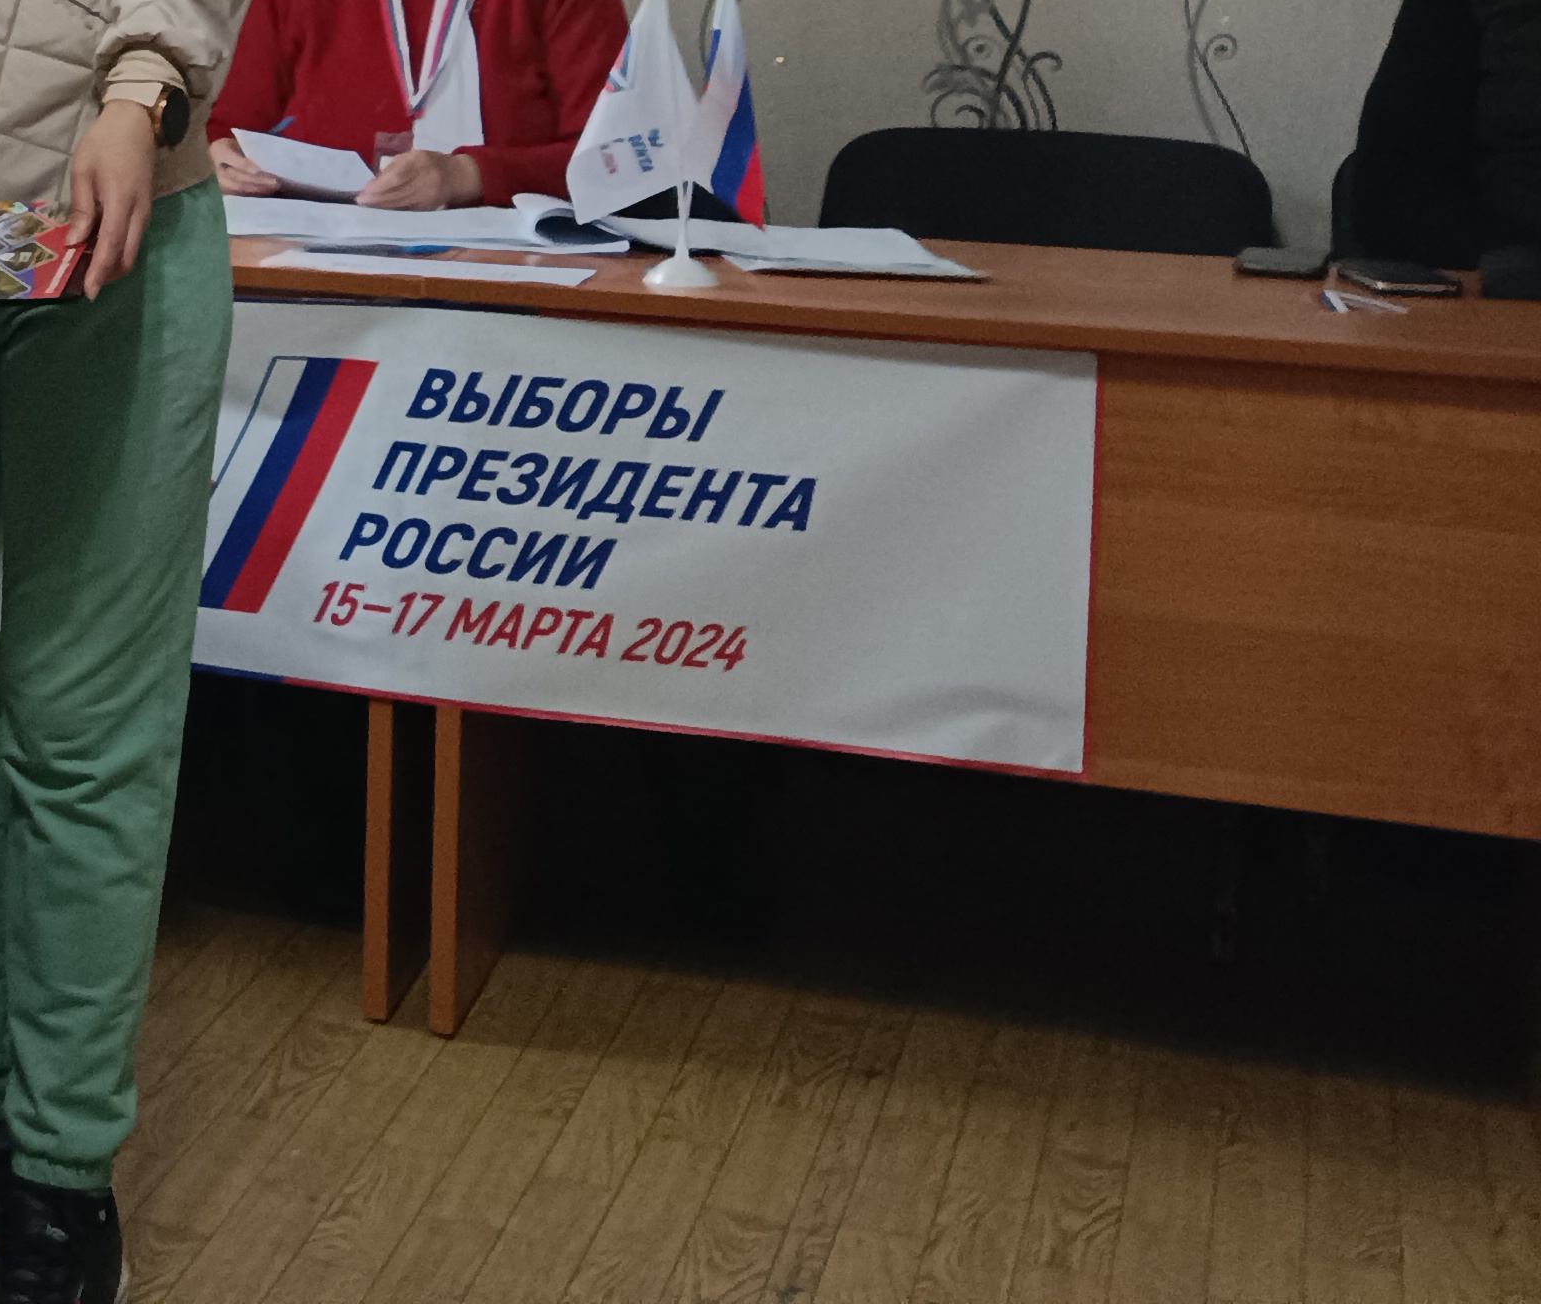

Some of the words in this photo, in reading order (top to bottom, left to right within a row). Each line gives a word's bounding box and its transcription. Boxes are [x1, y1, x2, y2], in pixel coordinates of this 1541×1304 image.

[406, 368, 725, 441] ВЫБОРЫ
[372, 440, 817, 532] ПРЕЗИДЕНТА
[338, 512, 616, 590] РОССИИ
[445, 598, 614, 660] МАРТА
[621, 617, 748, 672] 2024
